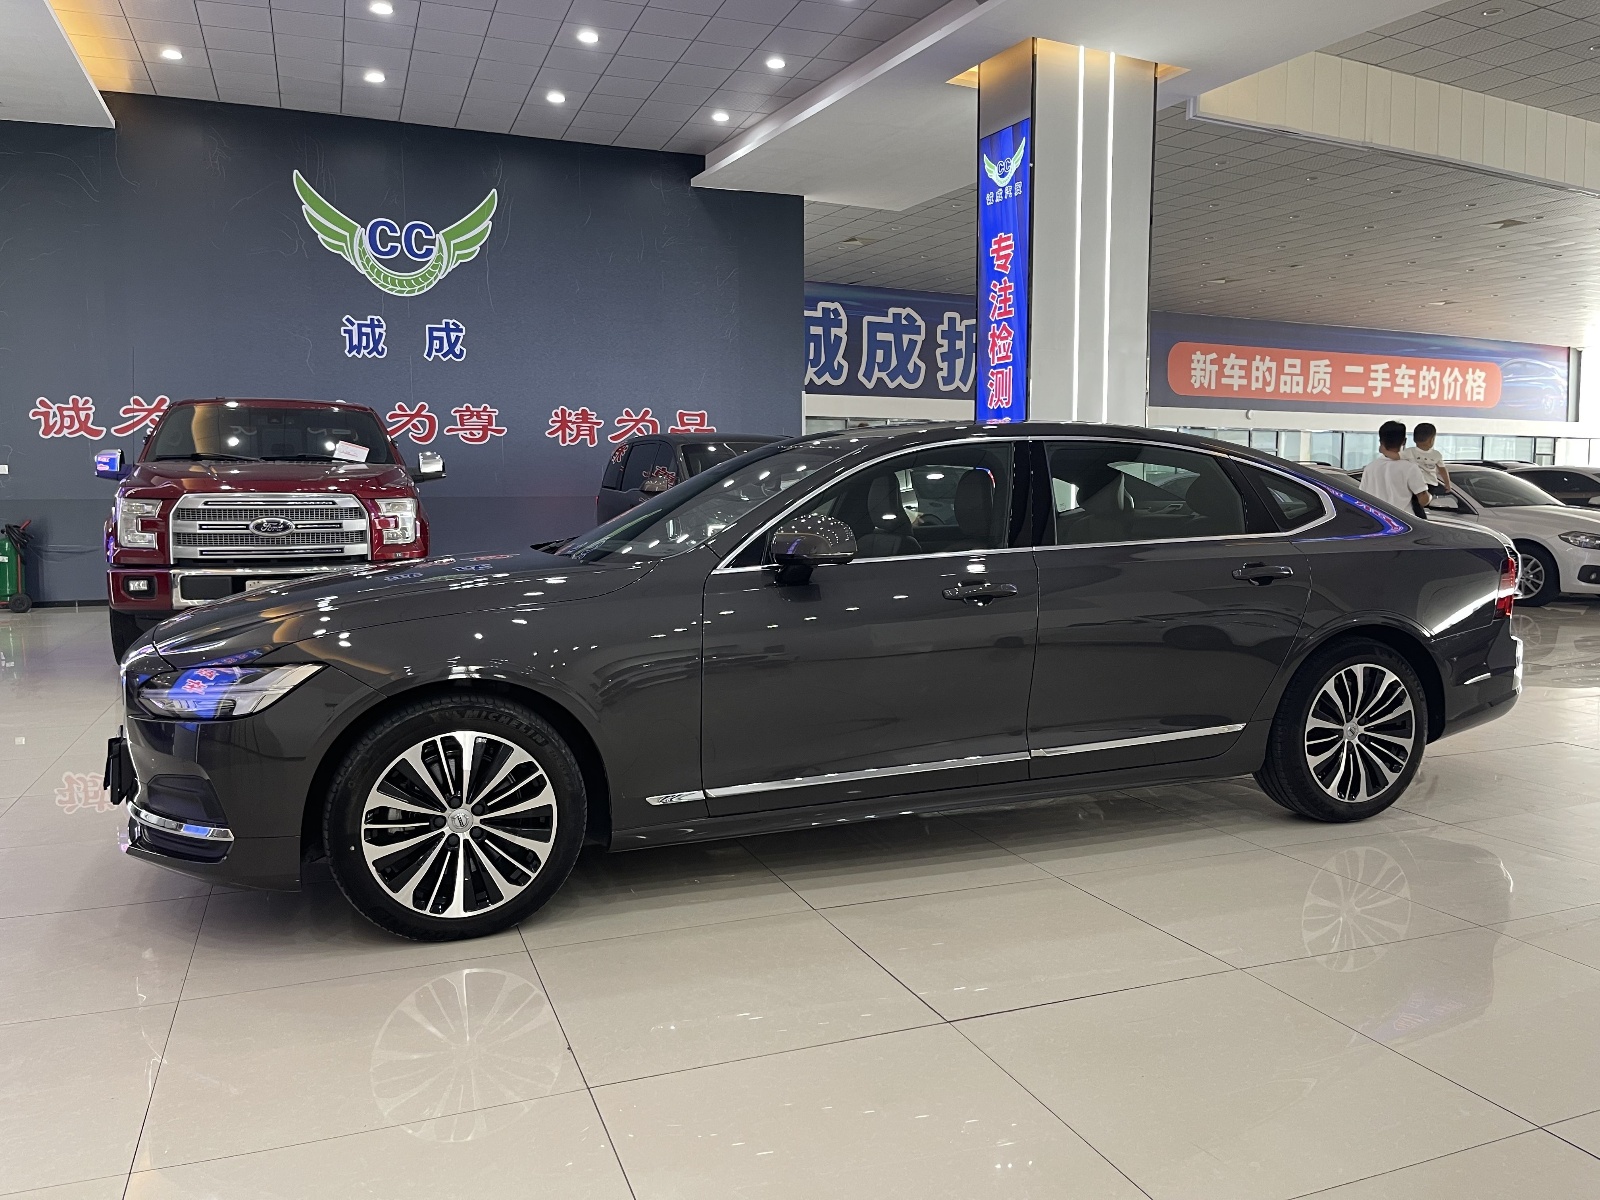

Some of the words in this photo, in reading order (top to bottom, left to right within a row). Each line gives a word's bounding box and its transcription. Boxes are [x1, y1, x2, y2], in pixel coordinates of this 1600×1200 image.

[997, 157, 1012, 175] CC
[366, 218, 437, 261] CC
[988, 232, 1015, 424] 专注检测
[1190, 350, 1332, 395] 新车的品质
[1341, 362, 1488, 402] 二手车的价格
[463, 708, 551, 748] MICHELIN
